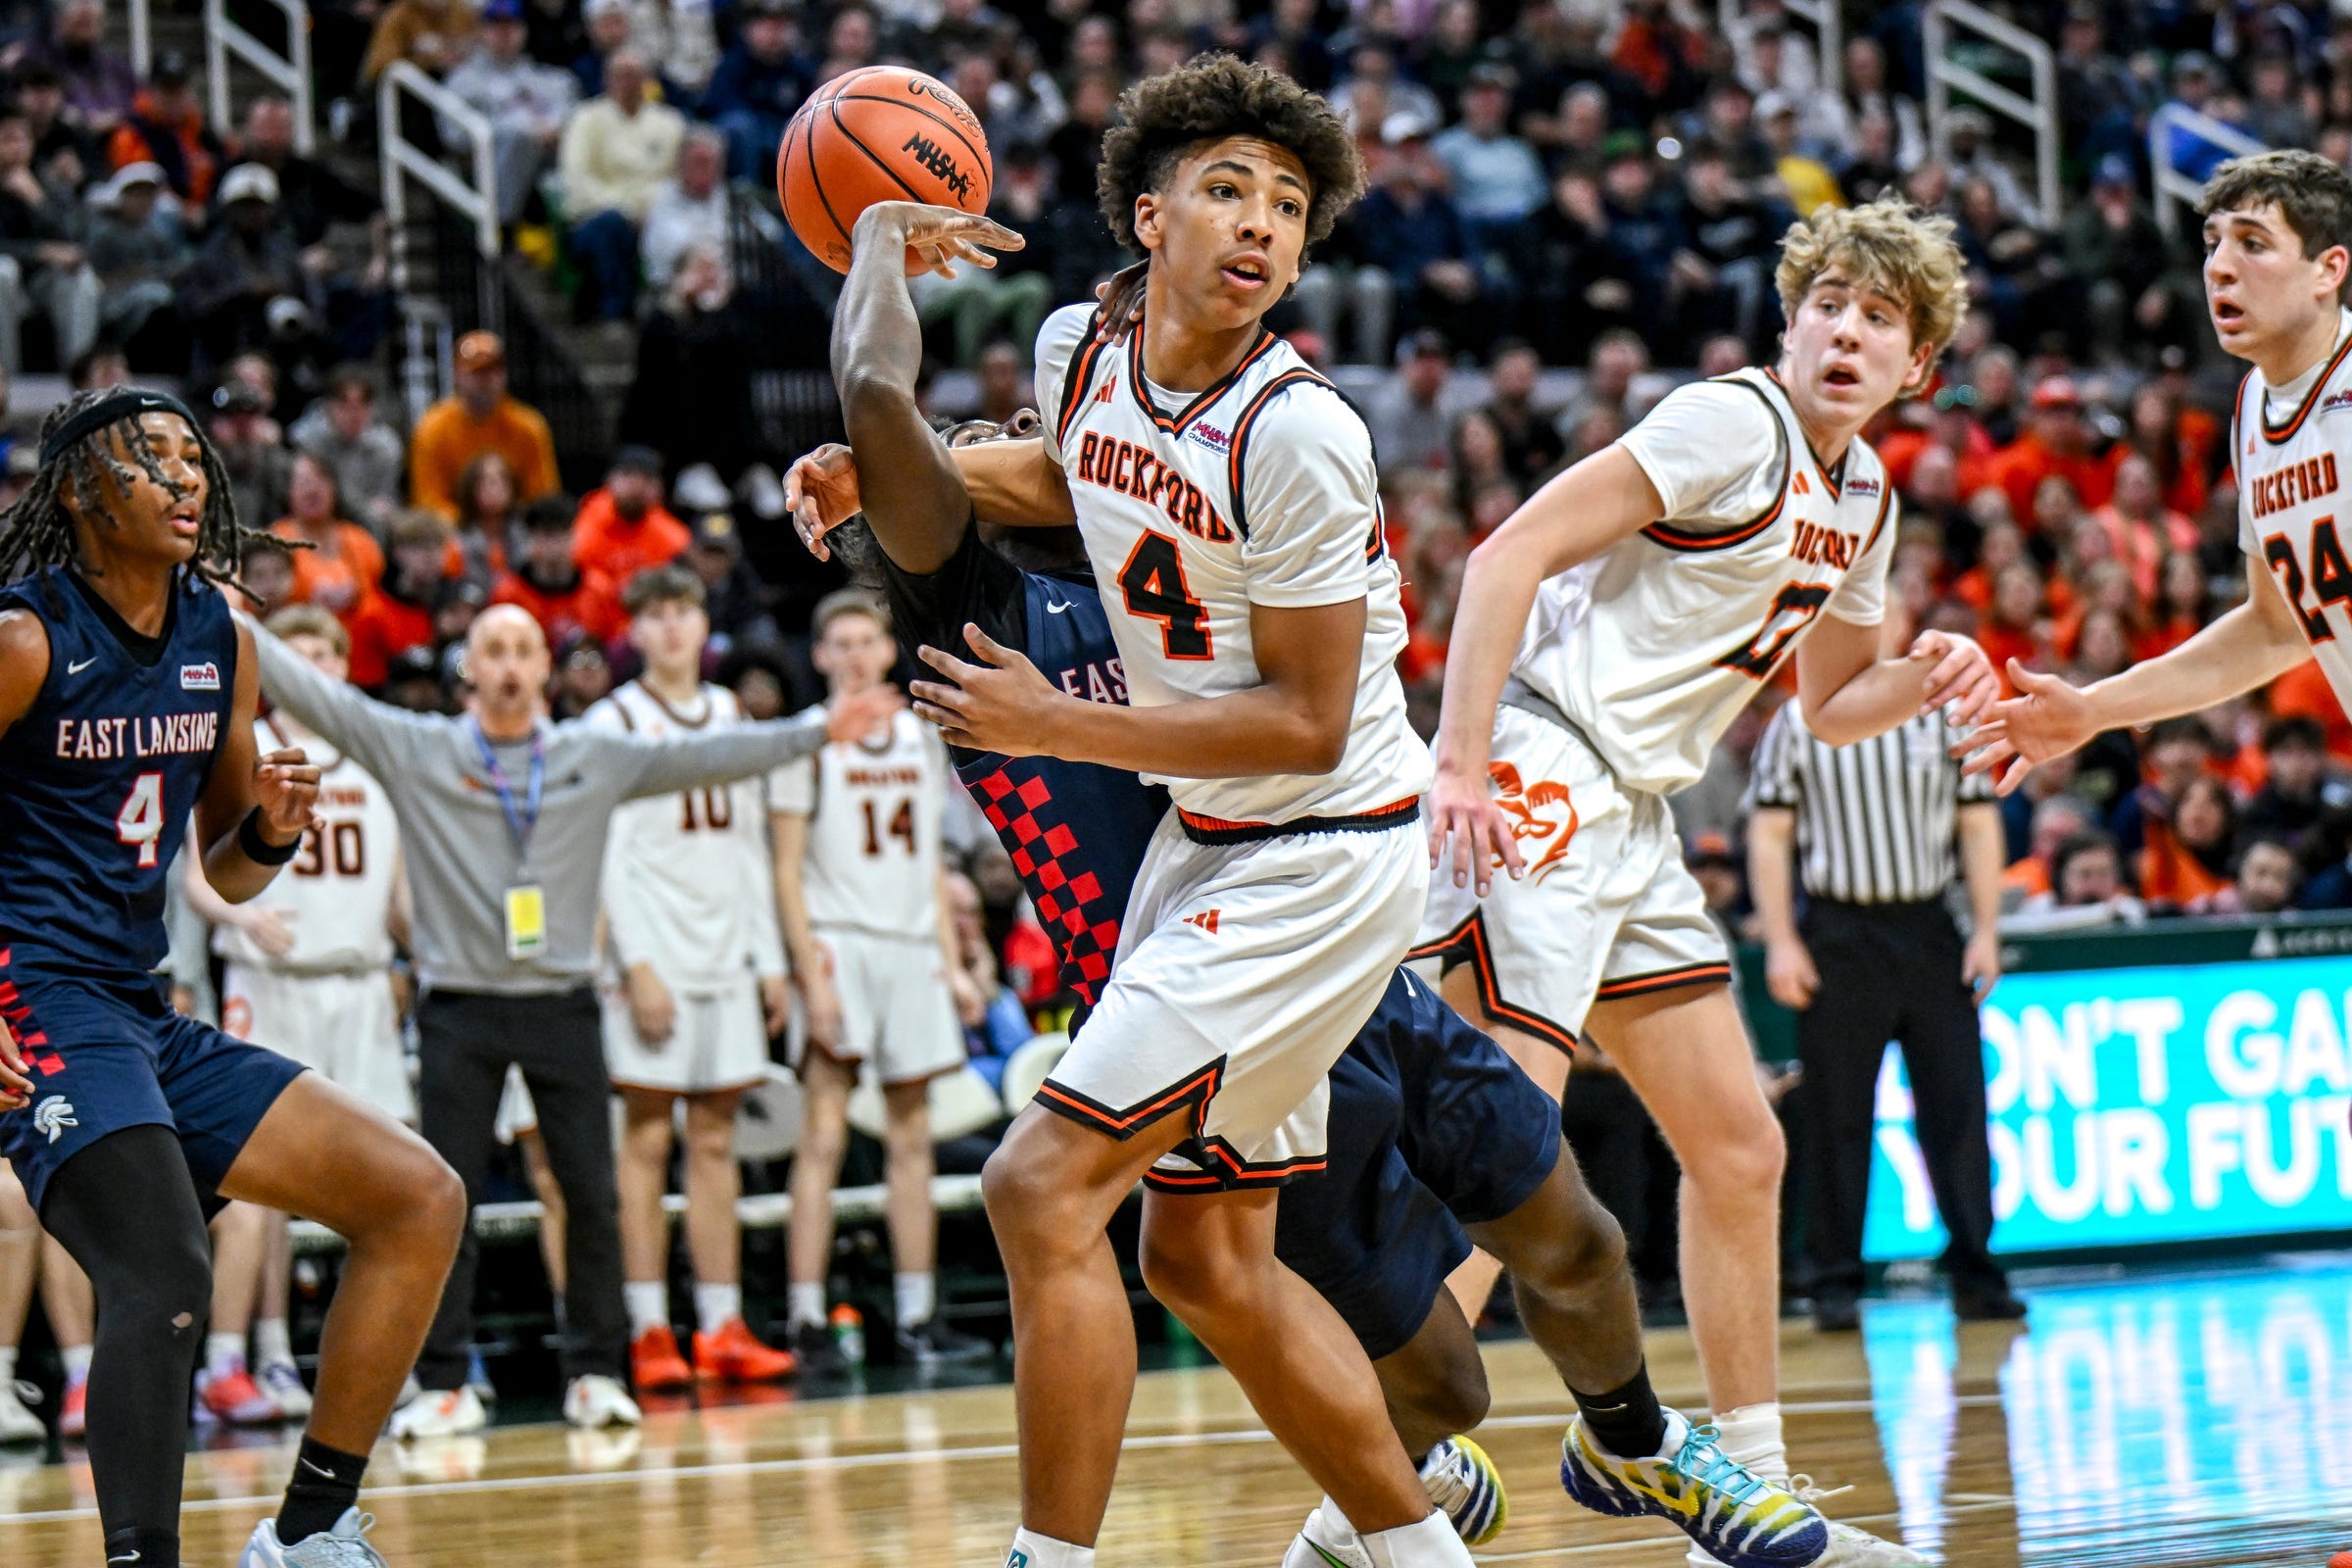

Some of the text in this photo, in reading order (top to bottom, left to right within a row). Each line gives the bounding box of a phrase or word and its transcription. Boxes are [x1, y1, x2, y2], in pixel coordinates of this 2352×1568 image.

[1078, 430, 1235, 544] ROCKFORD
[1117, 528, 1214, 661] 4
[2263, 514, 2352, 645] 24
[56, 711, 219, 760] EAST LANSING
[115, 771, 168, 867] 4
[292, 821, 364, 876] 30
[862, 798, 915, 856] 14
[1874, 988, 2352, 1119] N'T GA
